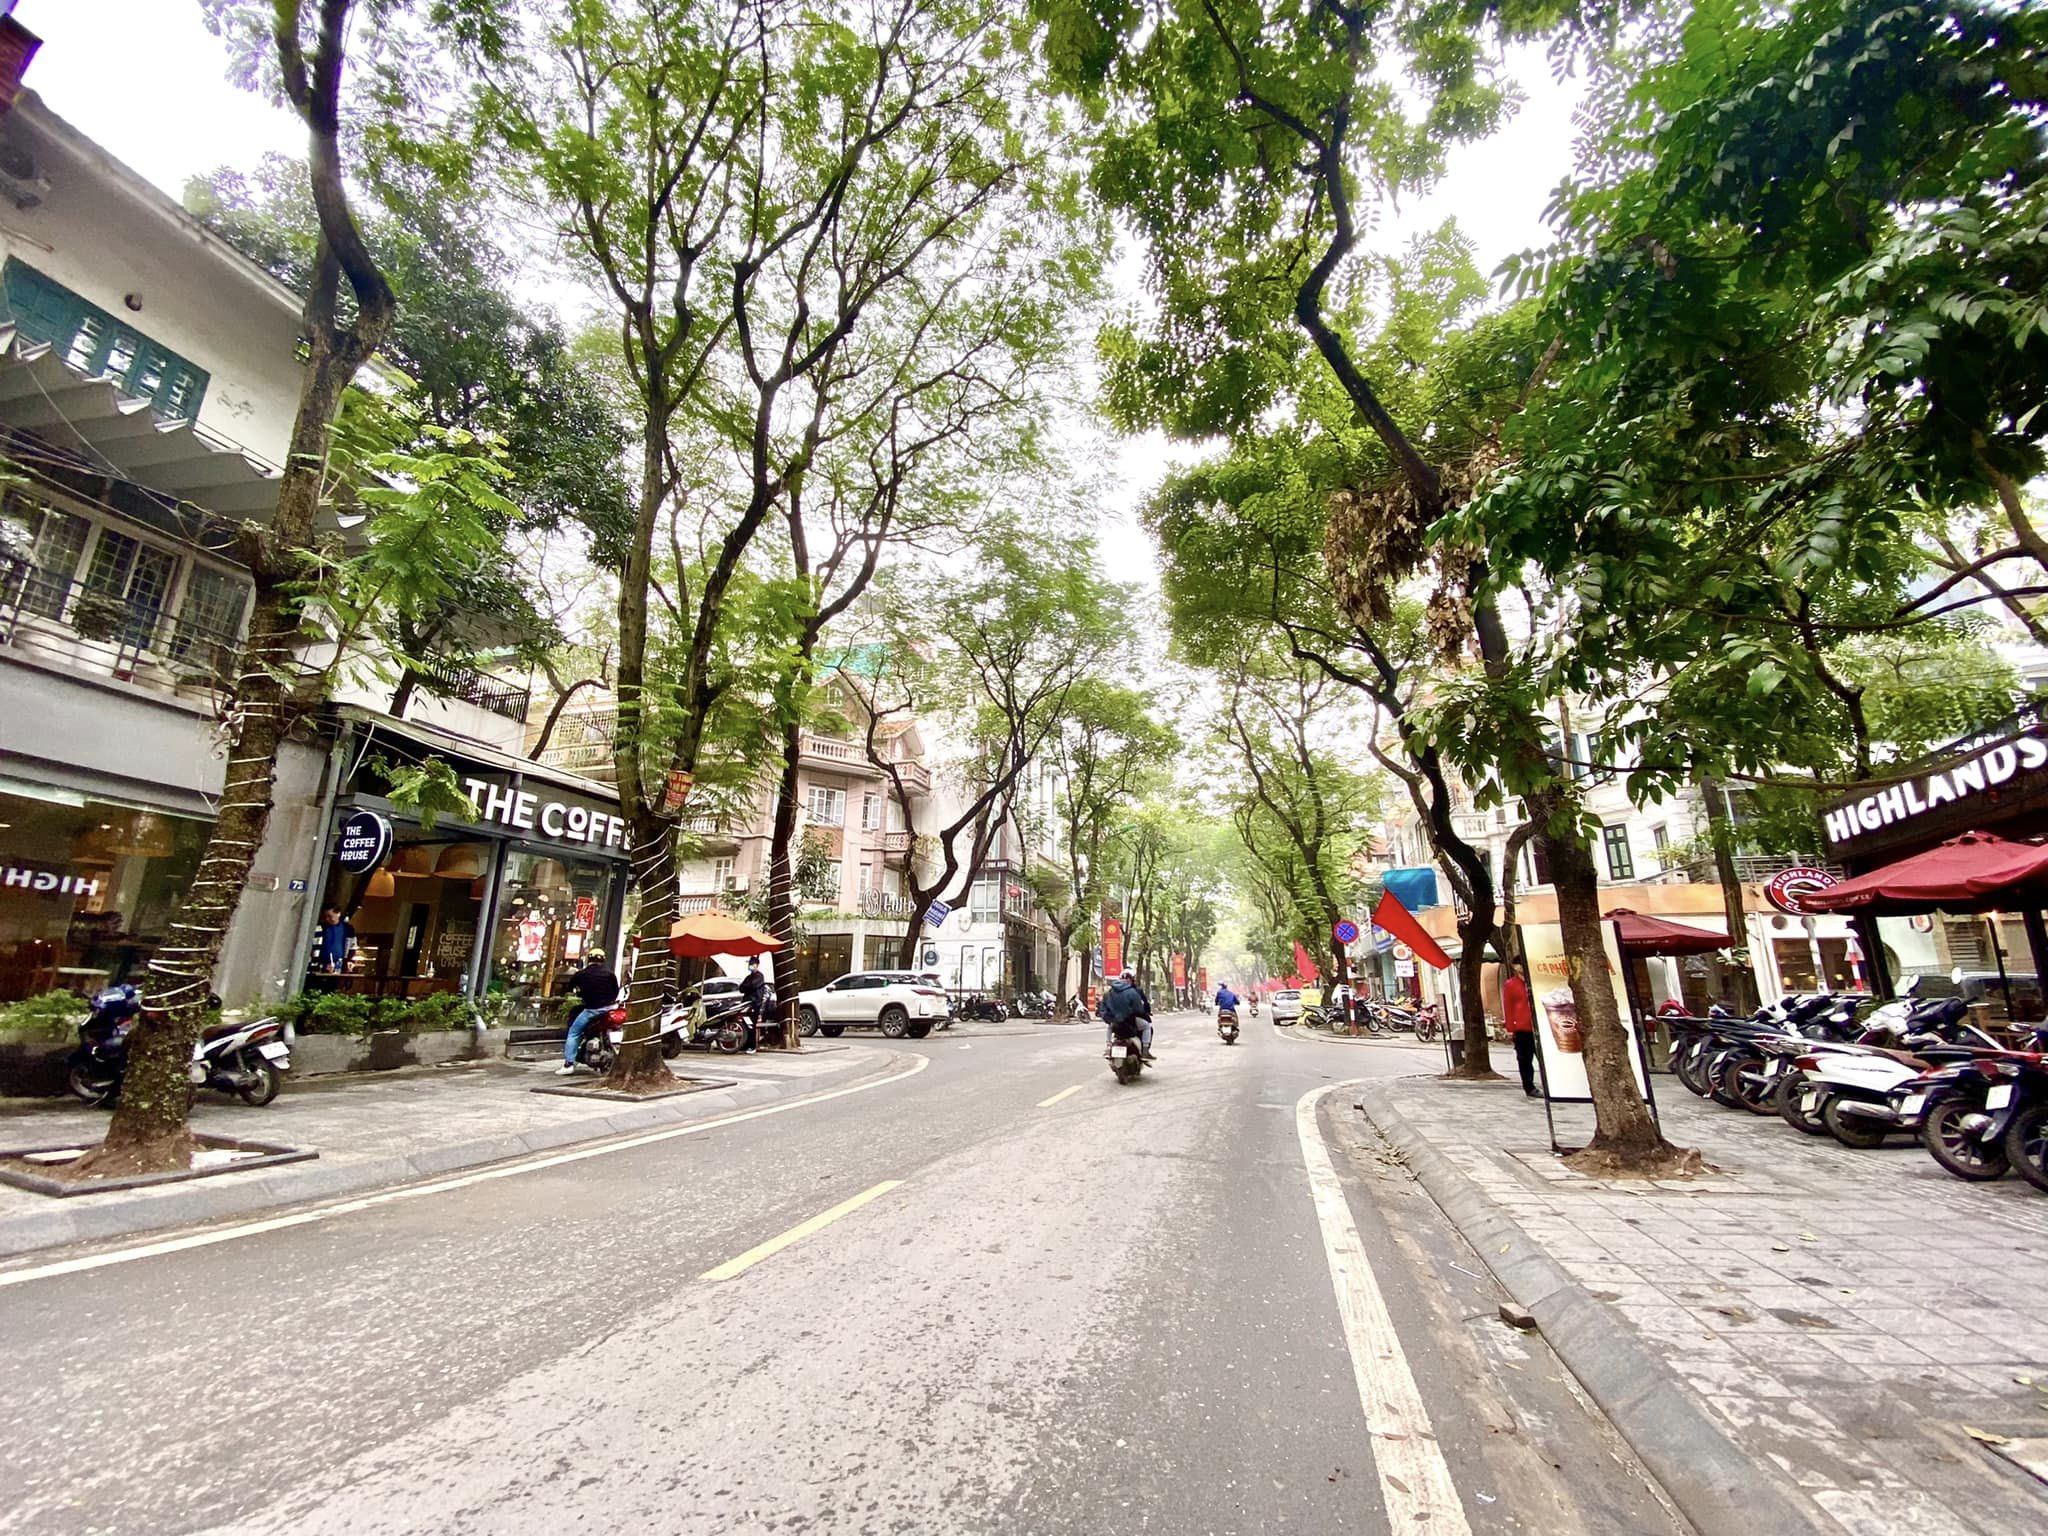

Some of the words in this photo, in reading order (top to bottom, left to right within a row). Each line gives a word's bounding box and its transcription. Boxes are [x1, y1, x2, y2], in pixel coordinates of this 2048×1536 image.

[1825, 737, 2048, 843] HIGHLANDS
[465, 777, 538, 829] THE
[346, 825, 362, 836] THE
[343, 837, 376, 849] COFFEE
[340, 850, 369, 861] HOUSE
